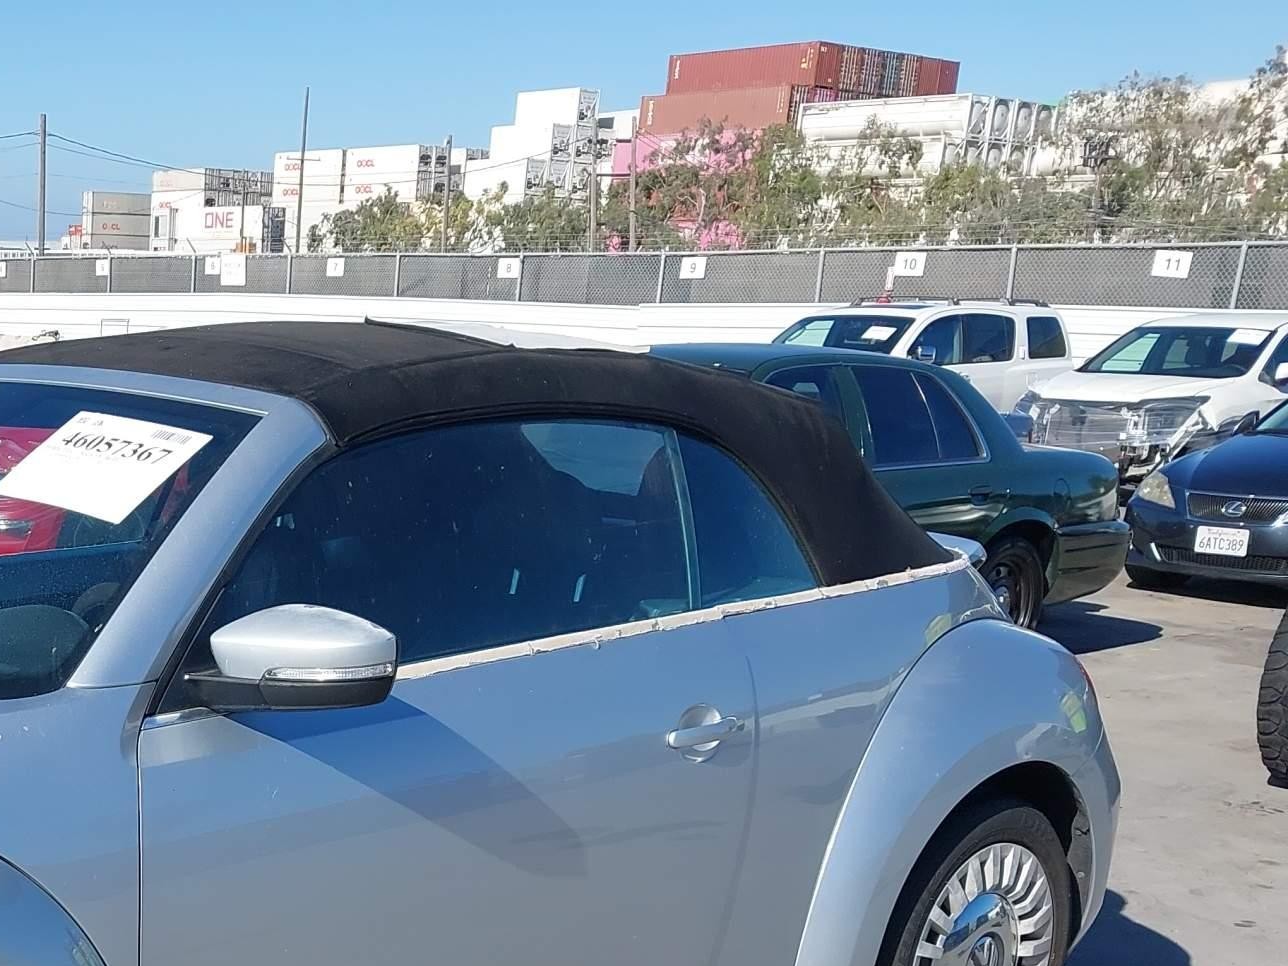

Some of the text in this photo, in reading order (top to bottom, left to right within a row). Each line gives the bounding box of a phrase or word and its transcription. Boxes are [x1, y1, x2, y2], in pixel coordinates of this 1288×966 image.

[102, 222, 120, 231] OCL
[204, 211, 234, 229] ONE
[689, 262, 697, 274] 9
[903, 258, 917, 271] 10
[1165, 258, 1181, 271] 11
[62, 431, 173, 465] 46057367
[1198, 536, 1245, 552] 6ATC389
